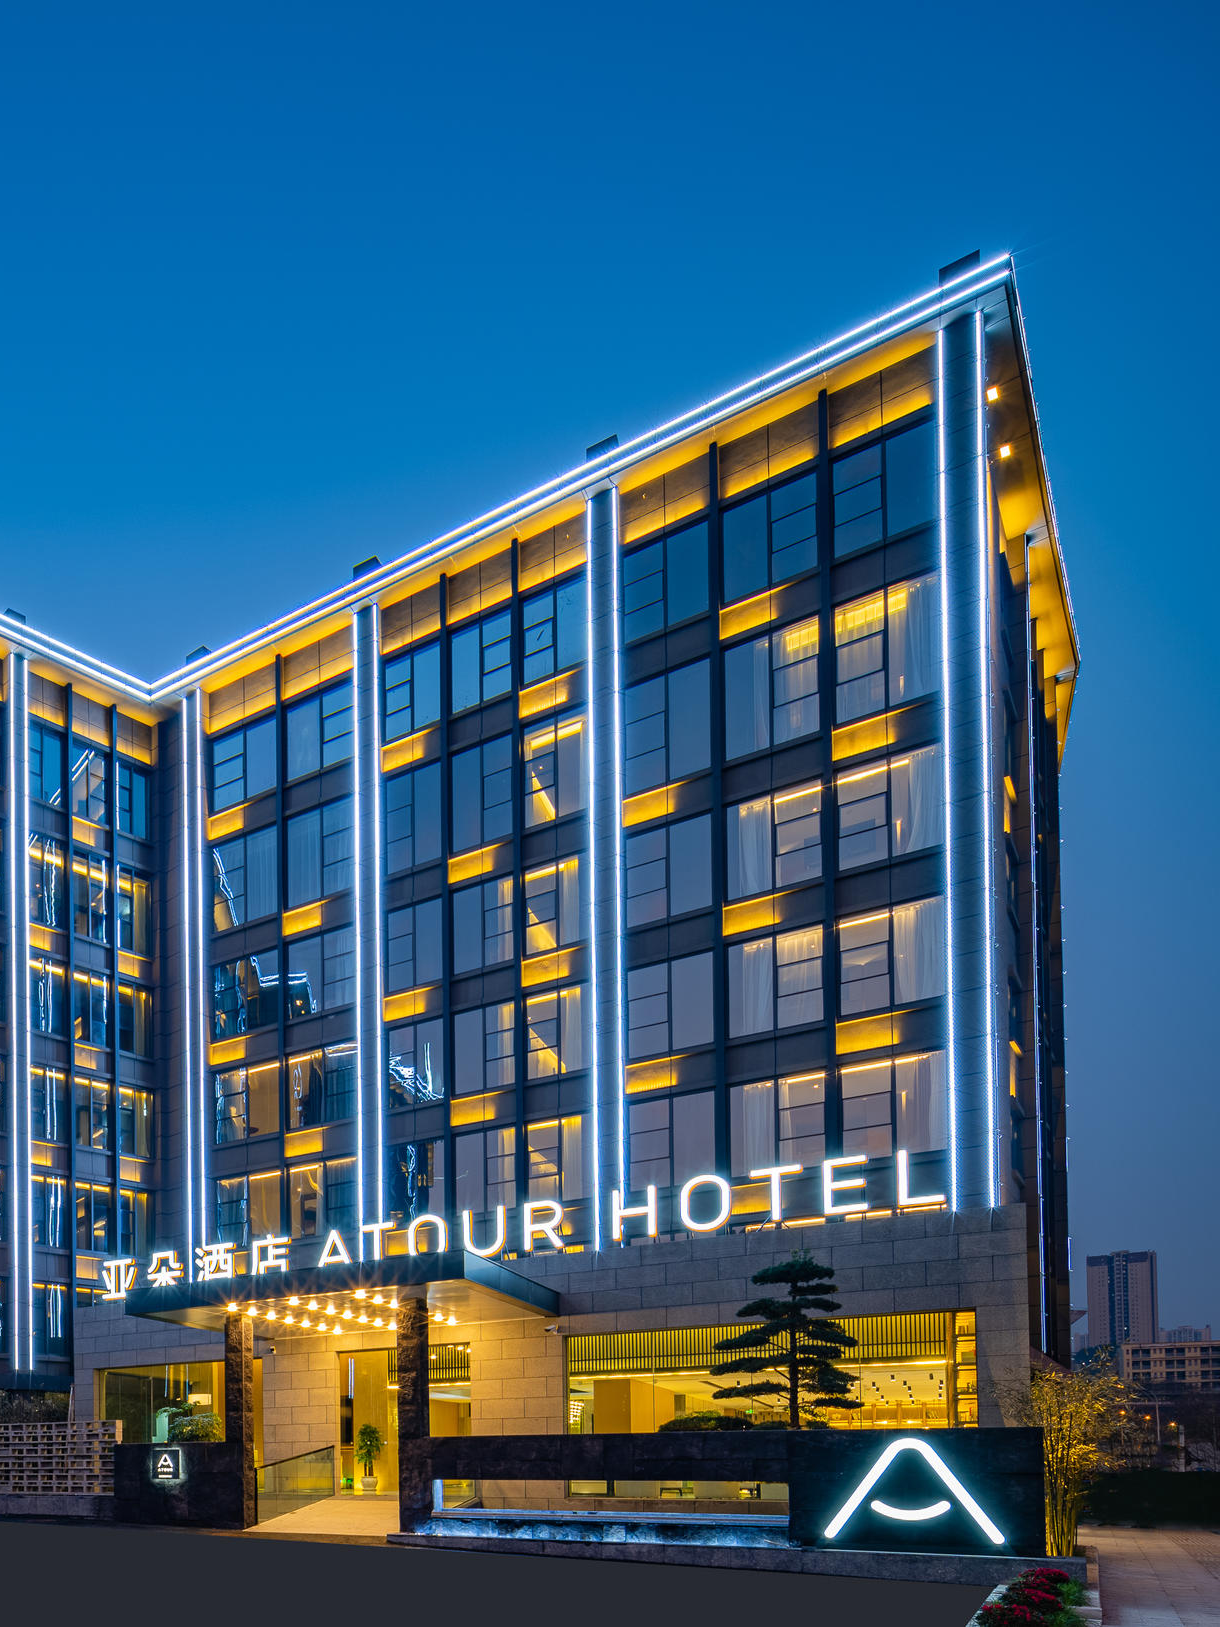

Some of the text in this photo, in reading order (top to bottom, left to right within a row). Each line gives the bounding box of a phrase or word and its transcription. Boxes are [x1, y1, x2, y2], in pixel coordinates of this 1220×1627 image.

[318, 1150, 946, 1267] ATOUR HOTEL
[101, 1234, 291, 1300] 亚朵酒店
